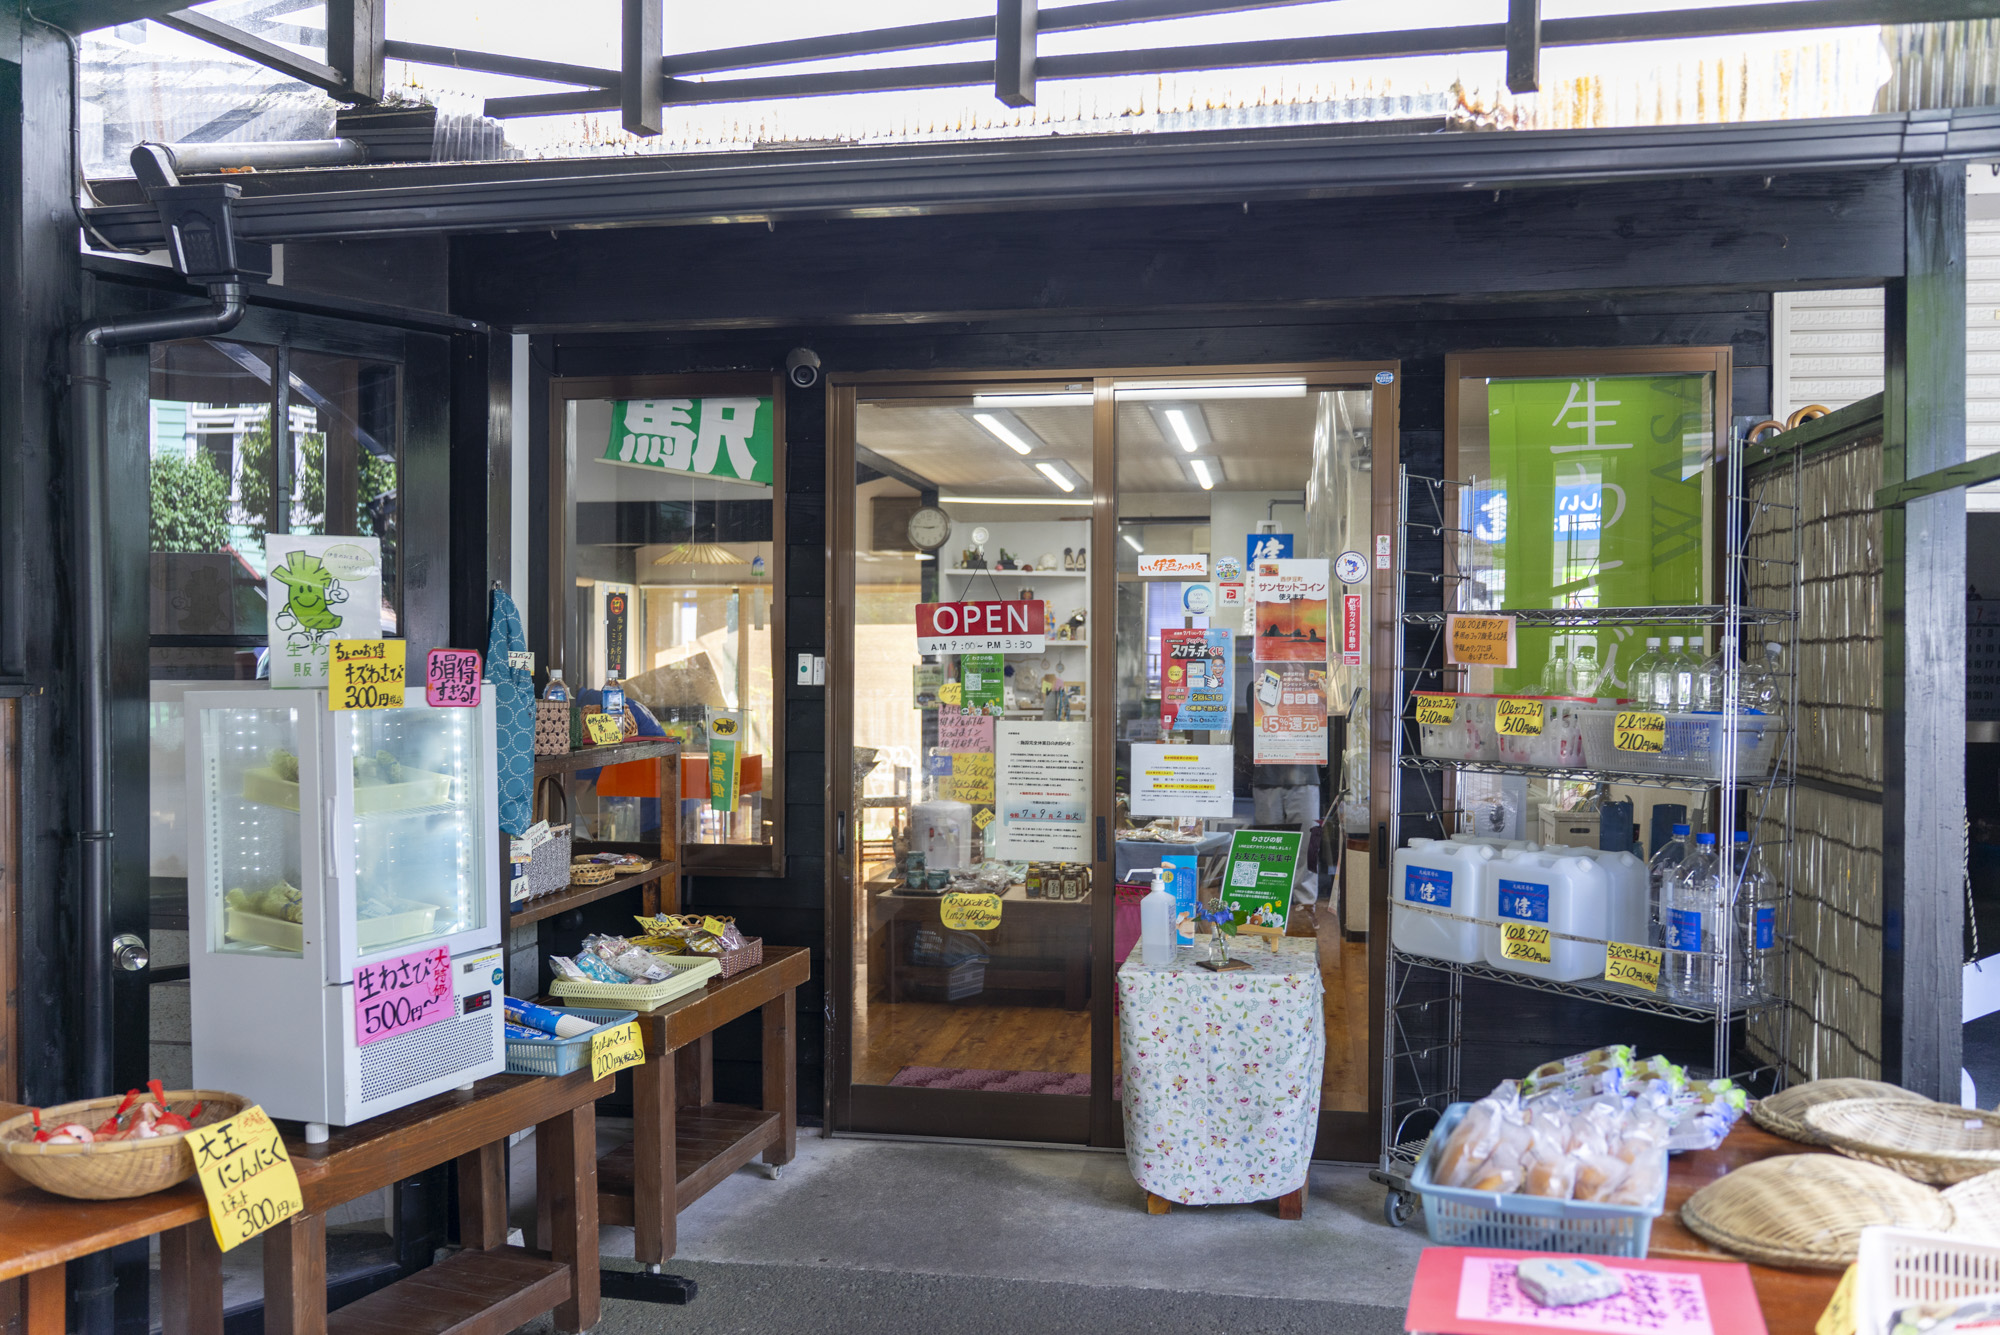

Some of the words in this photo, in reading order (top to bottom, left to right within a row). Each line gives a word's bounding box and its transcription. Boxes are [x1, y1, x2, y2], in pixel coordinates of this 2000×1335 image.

[1259, 583, 1325, 592] サンセットコイン
[933, 604, 1029, 634] OPEN
[1348, 597, 1357, 650] 防犯カメラ作動中
[931, 643, 947, 651] A.M
[987, 641, 1001, 649] P.M
[1171, 644, 1224, 657] スクラッチくじ
[345, 663, 404, 684] キズわさび
[430, 654, 478, 684] お買得
[1022, 809, 1028, 818] 7
[1040, 808, 1046, 818] 9
[1056, 810, 1062, 818] 2
[1251, 836, 1283, 844] わさびの駅
[1234, 852, 1292, 863] お友だち募集中
[1419, 881, 1436, 902] 健
[1514, 896, 1532, 917] 健
[359, 957, 433, 1003] 生わさび
[433, 949, 449, 997] 大特価
[199, 1123, 248, 1169] 大玉
[217, 1137, 288, 1189] にんにく
